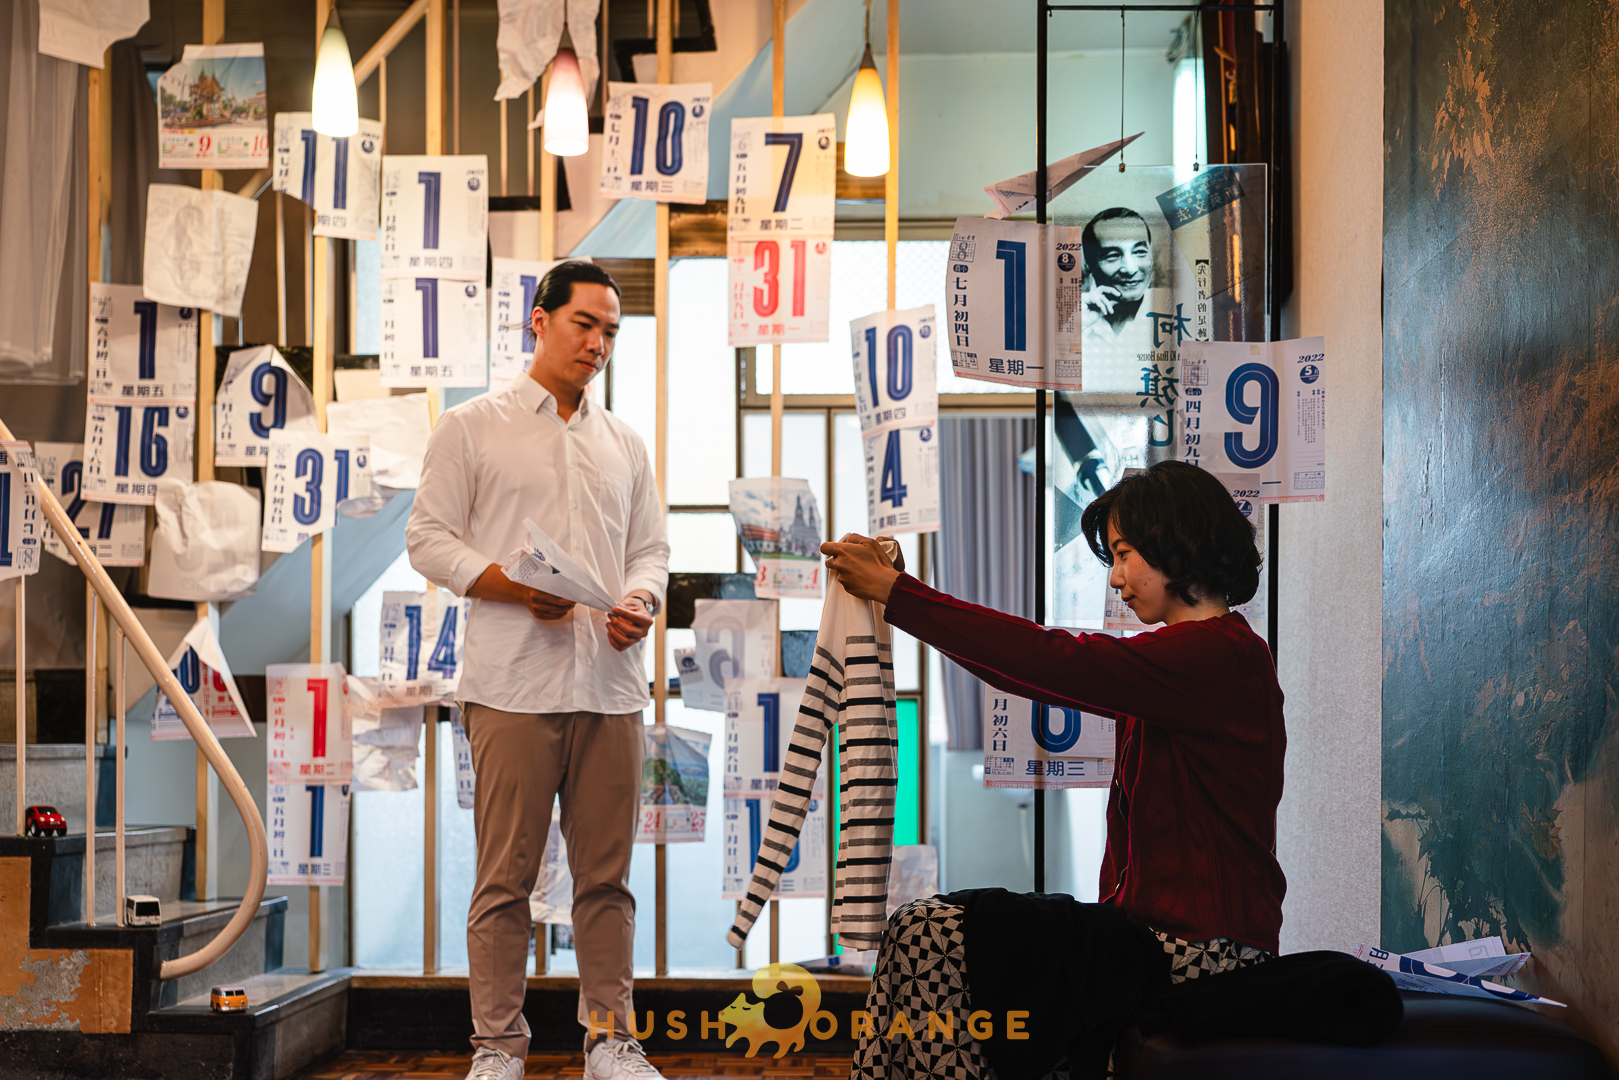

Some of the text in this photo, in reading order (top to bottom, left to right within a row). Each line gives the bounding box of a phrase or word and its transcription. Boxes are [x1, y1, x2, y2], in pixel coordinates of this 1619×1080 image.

[630, 96, 685, 176] 10
[630, 180, 674, 193] 星期三
[765, 133, 803, 213] 7
[418, 171, 441, 249] 1
[760, 219, 803, 230] 星期二
[409, 256, 453, 268] 星期四
[753, 240, 806, 318] 31
[1056, 243, 1082, 251] 2022
[415, 278, 438, 358] 1
[757, 324, 801, 336] 星期一
[952, 277, 969, 348] 七月初四日
[996, 240, 1026, 351] 1
[134, 301, 158, 380] 1
[865, 324, 913, 409] 10
[989, 358, 1044, 376] 星期一
[1297, 353, 1325, 364] 2022
[121, 385, 165, 397] 星期五
[249, 362, 288, 439] 9
[875, 407, 906, 426] 星期四
[1224, 363, 1280, 469] 9
[115, 406, 169, 477] 16
[880, 428, 907, 508] 4
[293, 448, 349, 526] 31
[879, 512, 911, 529] 星期三
[1232, 490, 1260, 498] 2022
[405, 606, 458, 681] 14
[306, 679, 328, 758] 1
[757, 693, 779, 772] 1
[299, 763, 335, 776] 星期二
[1025, 760, 1086, 777] 星期三
[305, 785, 324, 858] 1
[298, 862, 331, 876] 星期三
